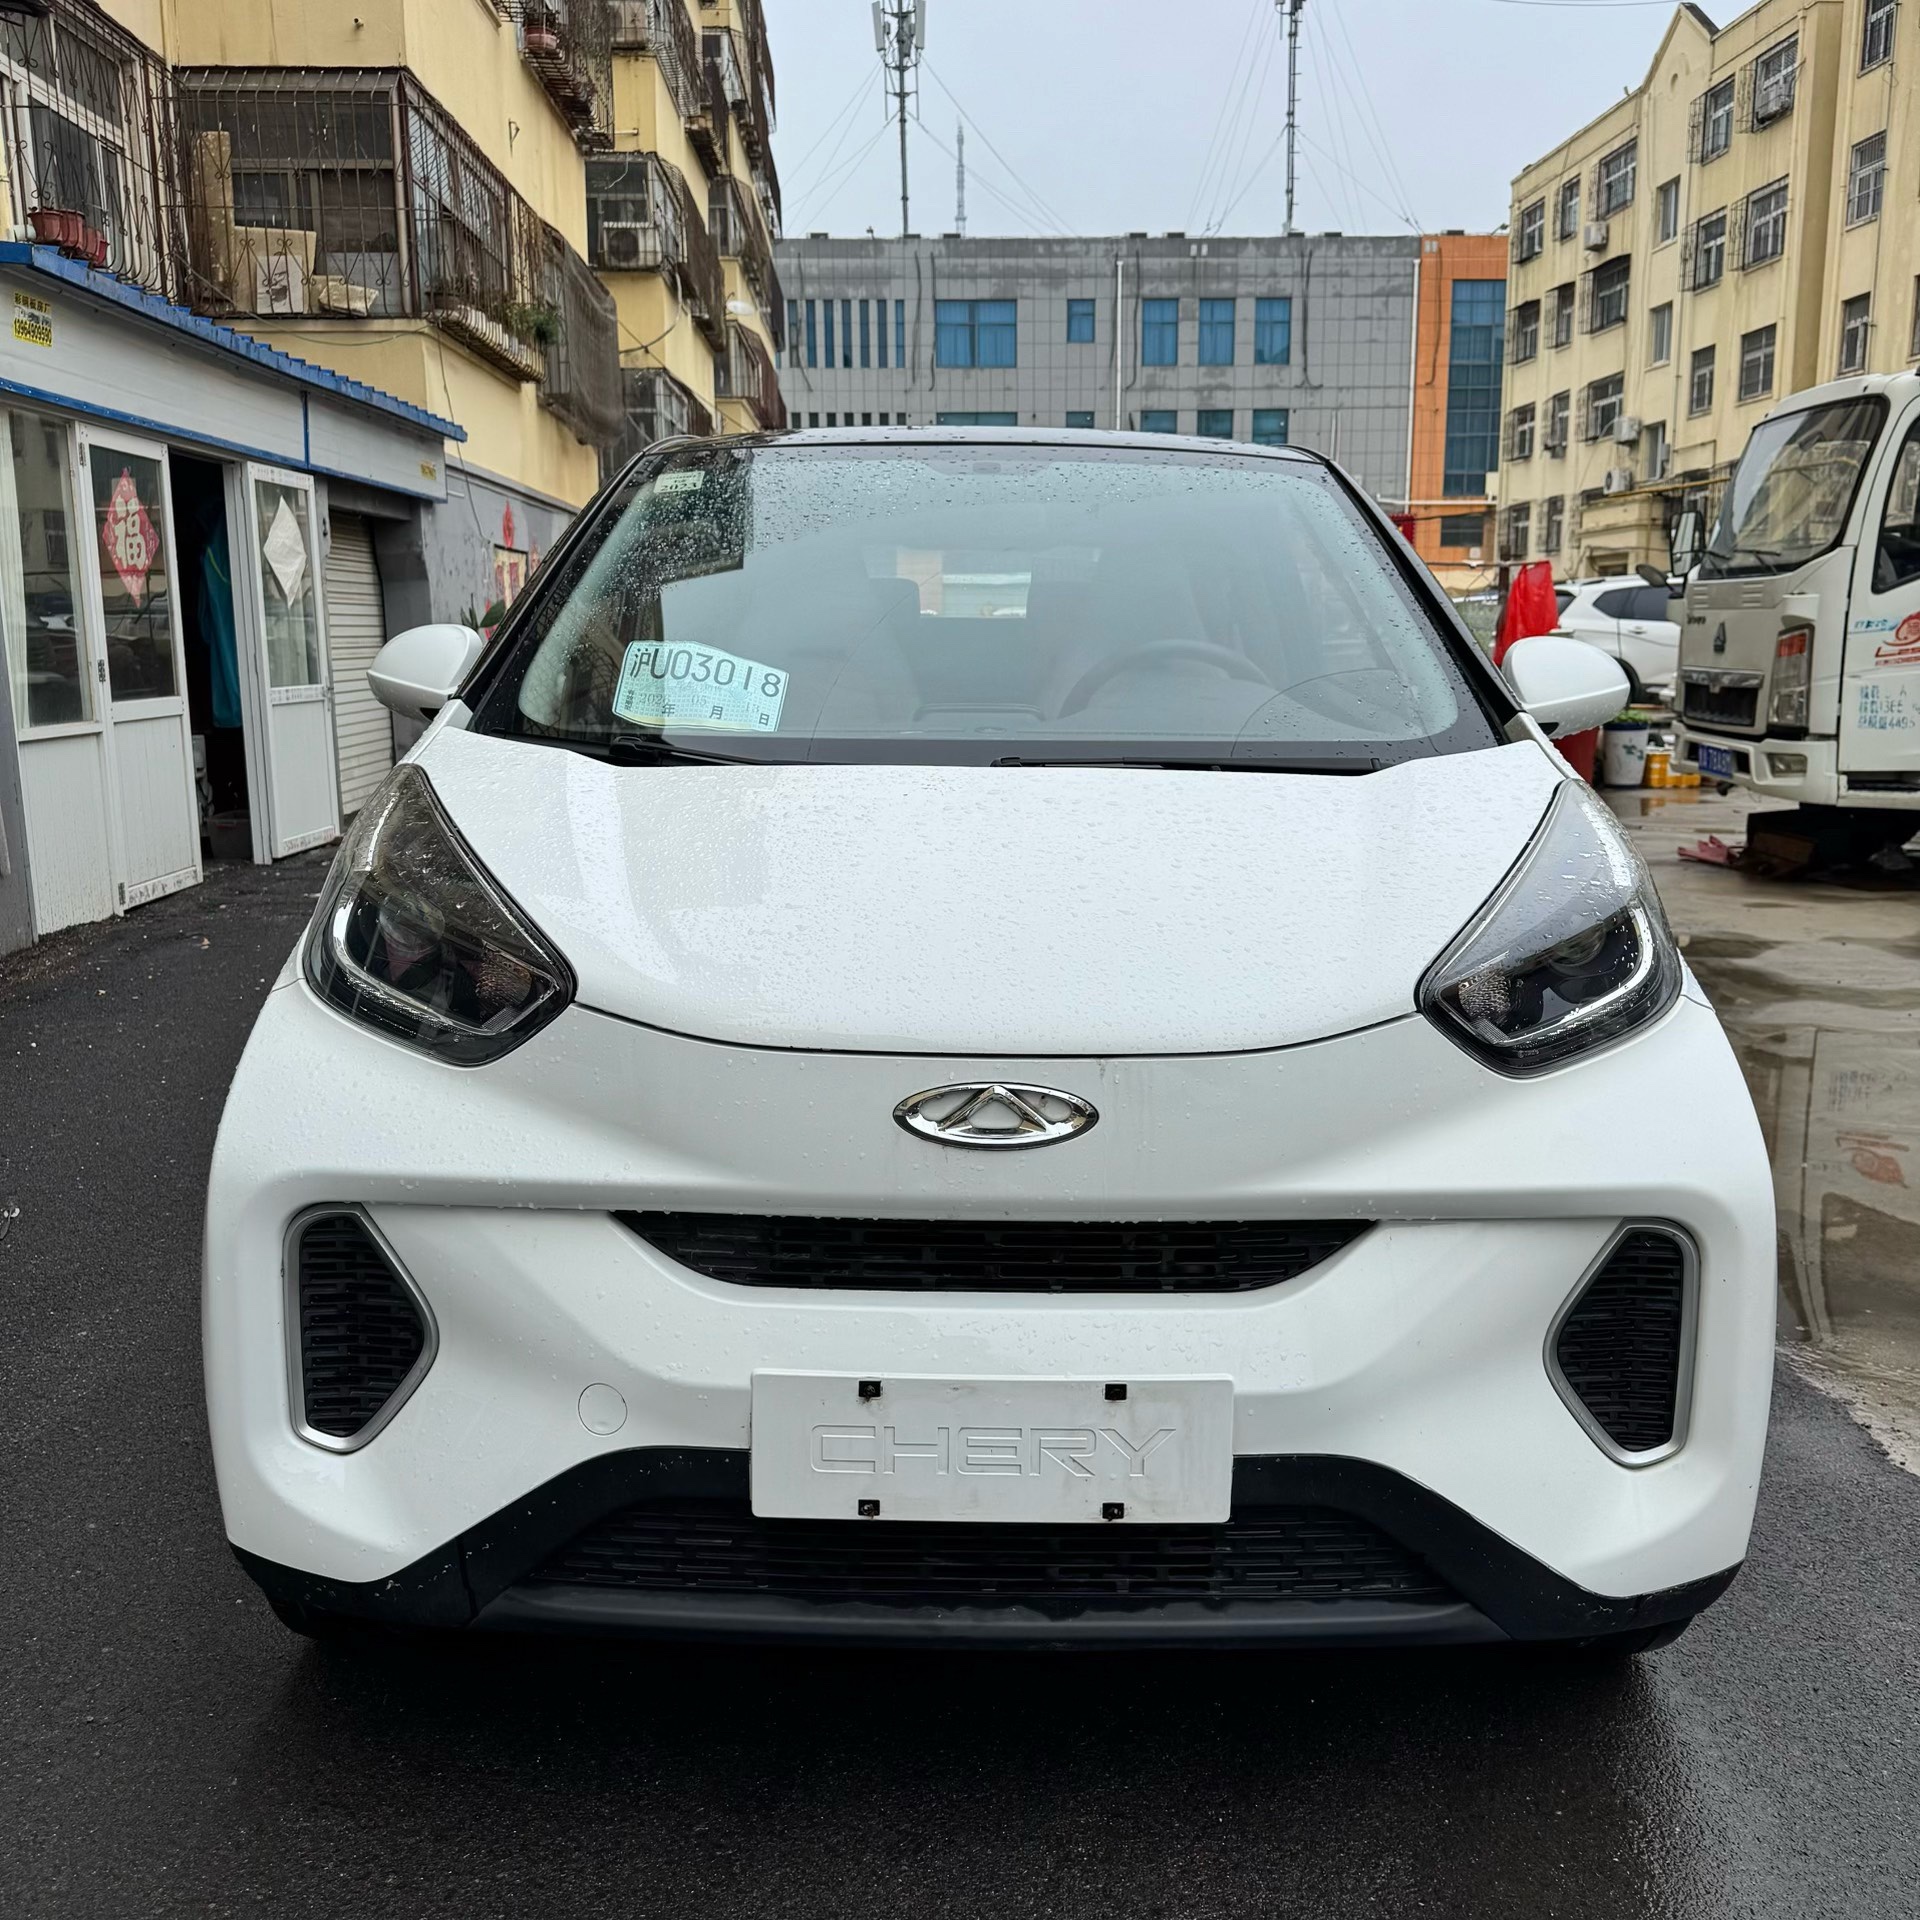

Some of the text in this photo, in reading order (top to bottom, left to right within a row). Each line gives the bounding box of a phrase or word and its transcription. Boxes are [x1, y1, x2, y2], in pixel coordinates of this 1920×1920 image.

[113, 496, 146, 570] 福
[629, 648, 781, 697] 沪U03018
[661, 703, 676, 717] 年
[709, 705, 724, 720] 月
[758, 712, 770, 726] 日
[810, 1424, 1177, 1478] CHERY
